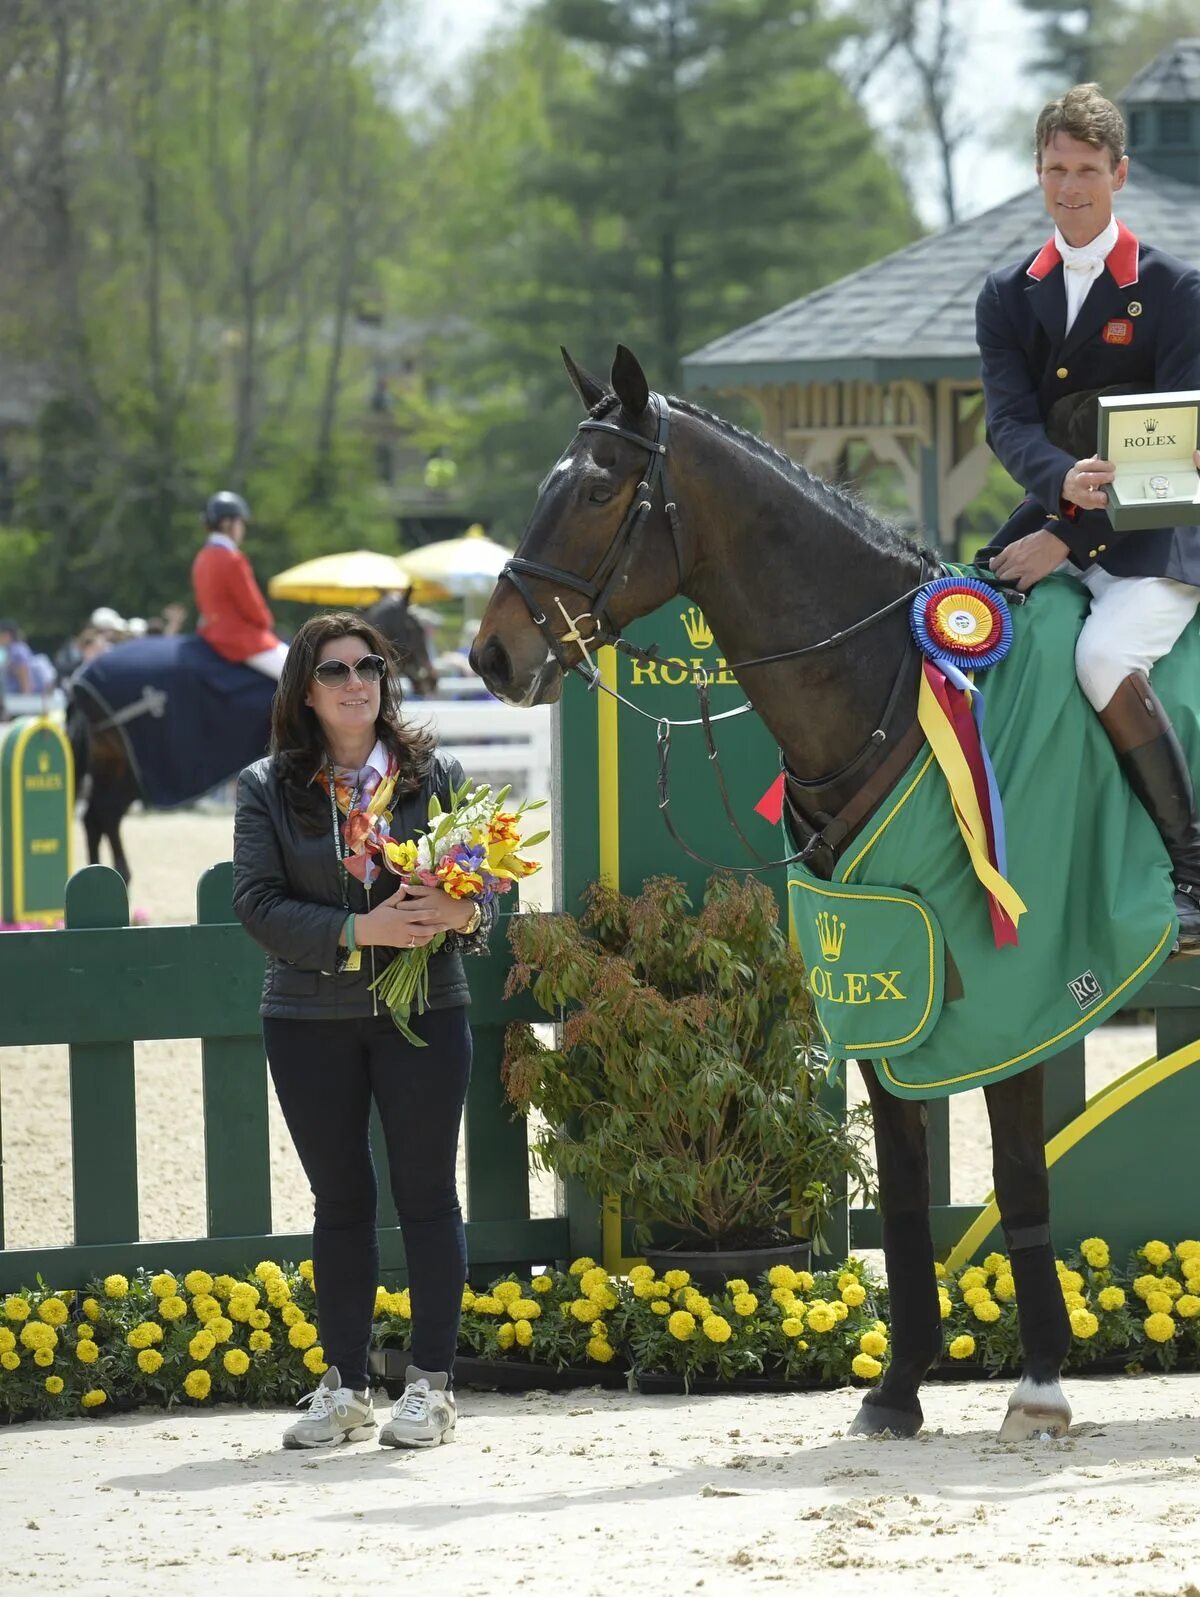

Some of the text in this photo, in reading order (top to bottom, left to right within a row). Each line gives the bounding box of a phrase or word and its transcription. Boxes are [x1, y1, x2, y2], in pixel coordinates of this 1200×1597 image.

[1123, 434, 1177, 448] ROLEX
[630, 657, 739, 685] ROLE
[809, 965, 908, 1004] OLEX
[1070, 973, 1098, 1002] RG
